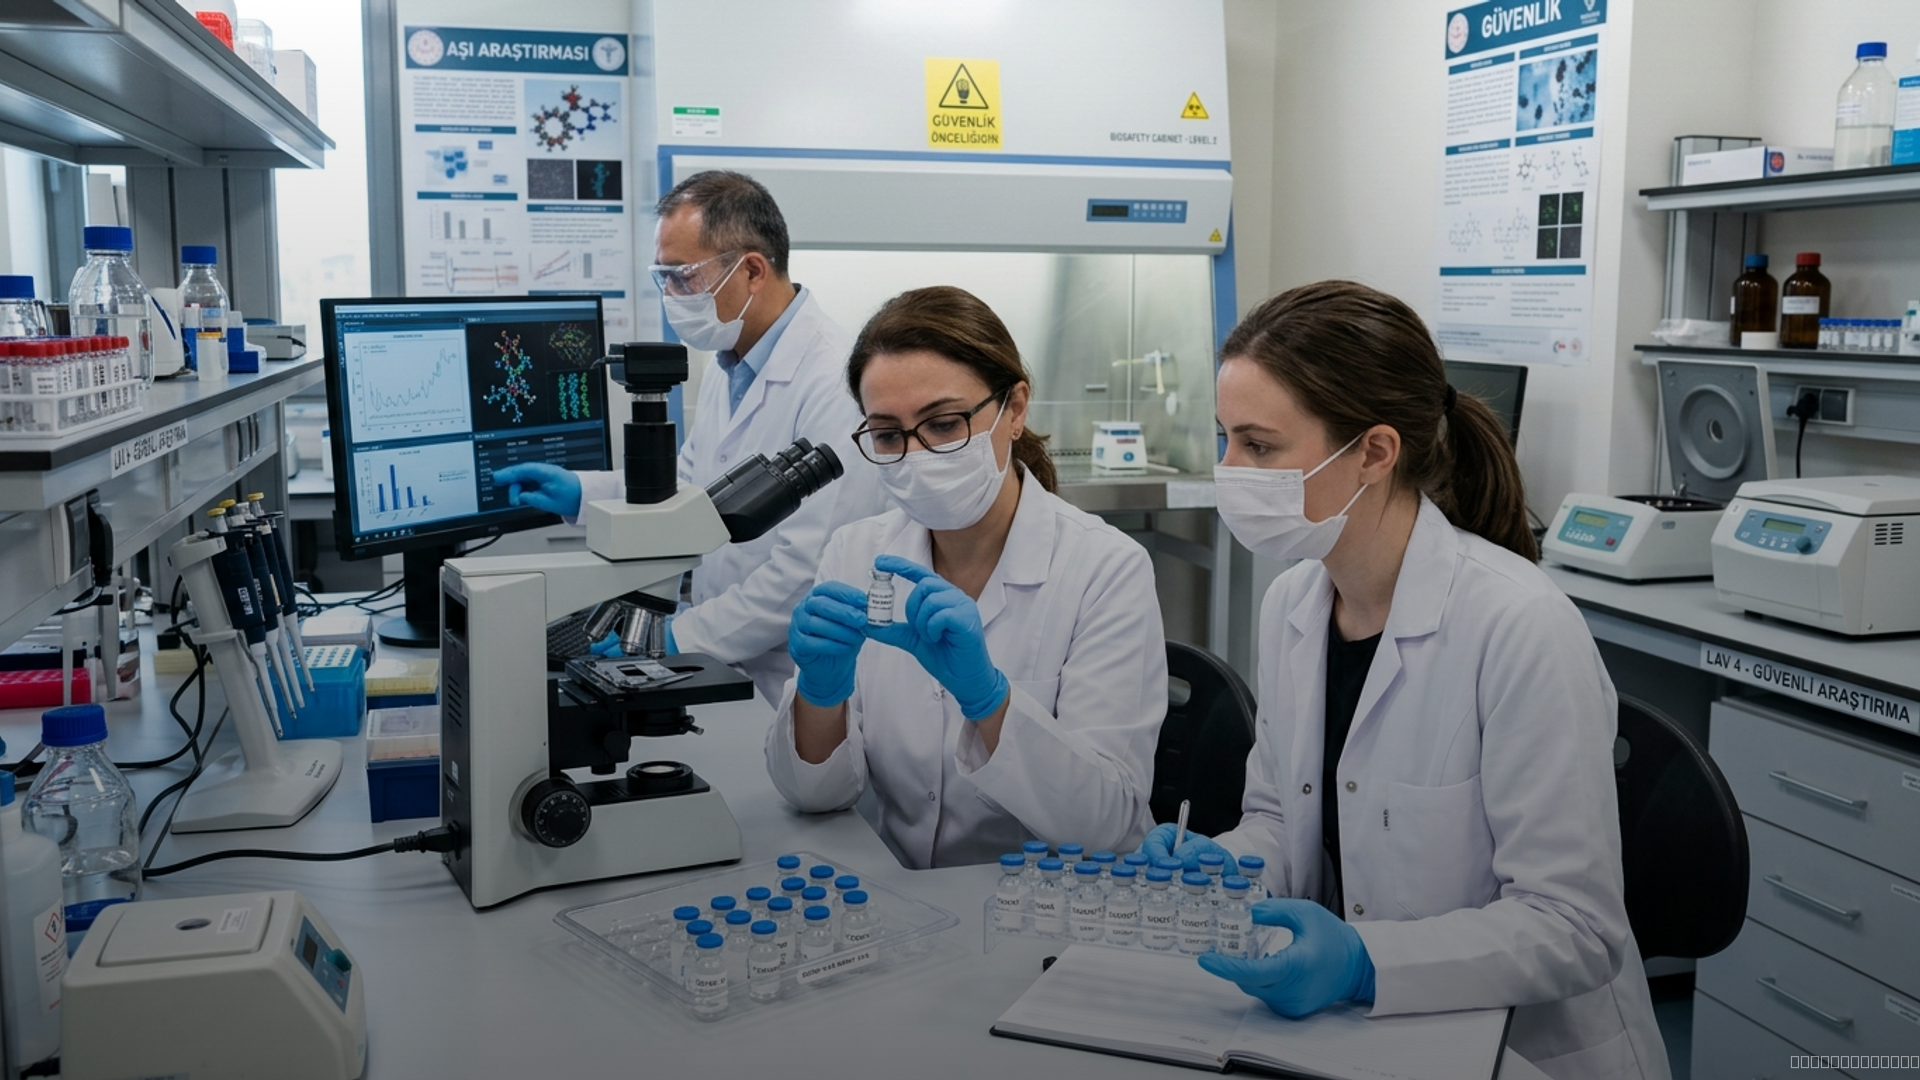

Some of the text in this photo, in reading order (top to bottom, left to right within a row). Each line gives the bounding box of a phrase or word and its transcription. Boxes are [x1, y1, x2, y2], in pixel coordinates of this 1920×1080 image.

[446, 41, 589, 62] AŞI ARAŞTIRMASI
[932, 113, 996, 128] GÜVENLİK
[1706, 650, 1732, 669] LAV
[1733, 658, 1741, 673] 4
[1753, 663, 1815, 695] GÜVENLİ
[1817, 682, 1910, 724] ARAŞTIRMA
